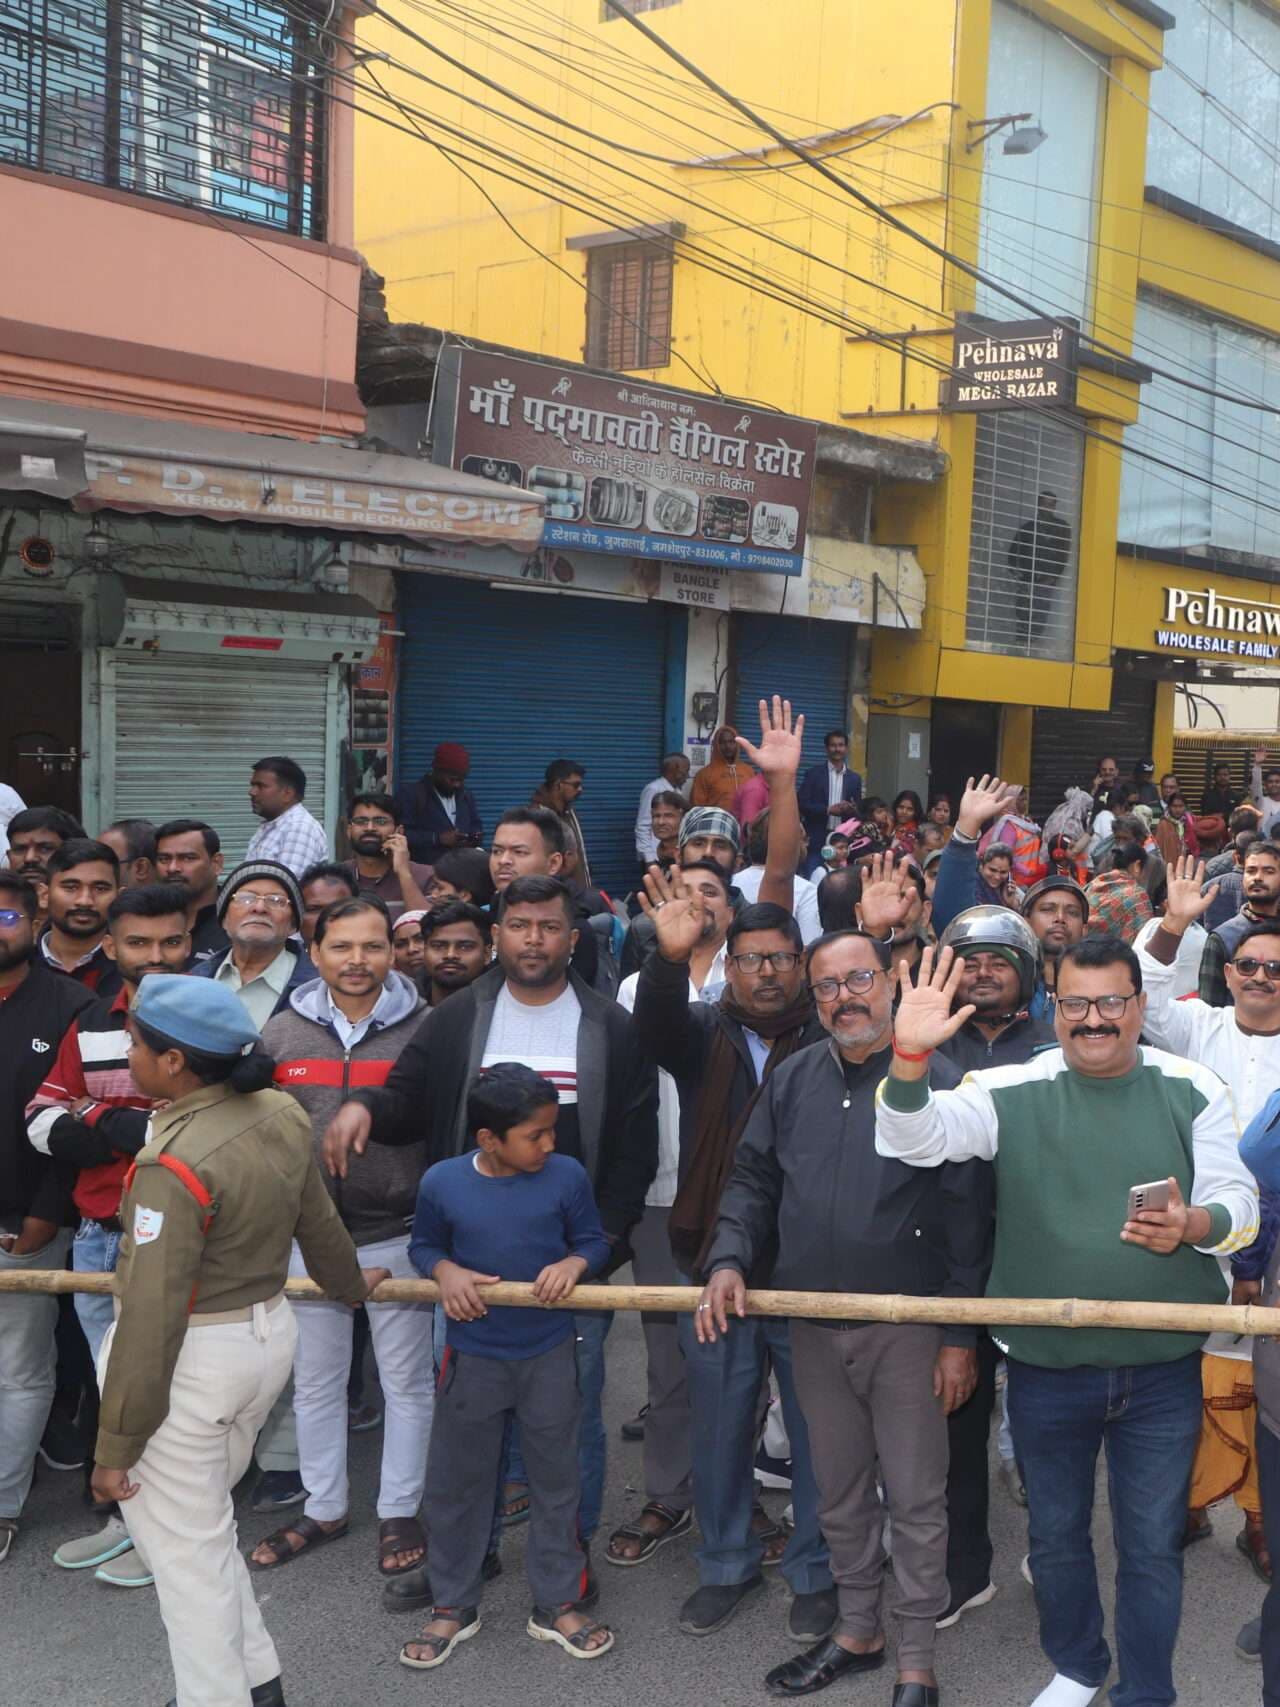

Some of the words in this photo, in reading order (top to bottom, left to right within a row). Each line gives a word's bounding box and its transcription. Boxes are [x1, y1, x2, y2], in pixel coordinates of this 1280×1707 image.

[958, 338, 1059, 369] Pehnawa
[973, 367, 1044, 382] WHOLESALE
[958, 385, 1001, 401] MEGA
[1006, 381, 1059, 399] BAZAR
[469, 377, 516, 427] माँ
[754, 437, 806, 479] स्टोर
[162, 463, 224, 495] D.
[247, 472, 521, 526] TELECOM
[172, 492, 249, 512] XEROX
[266, 502, 345, 521] MOBILE
[352, 510, 453, 530] RECHARGE
[673, 572, 721, 589] BANGLE
[677, 588, 715, 604] STORE
[1157, 631, 1235, 654] WHOLESALE
